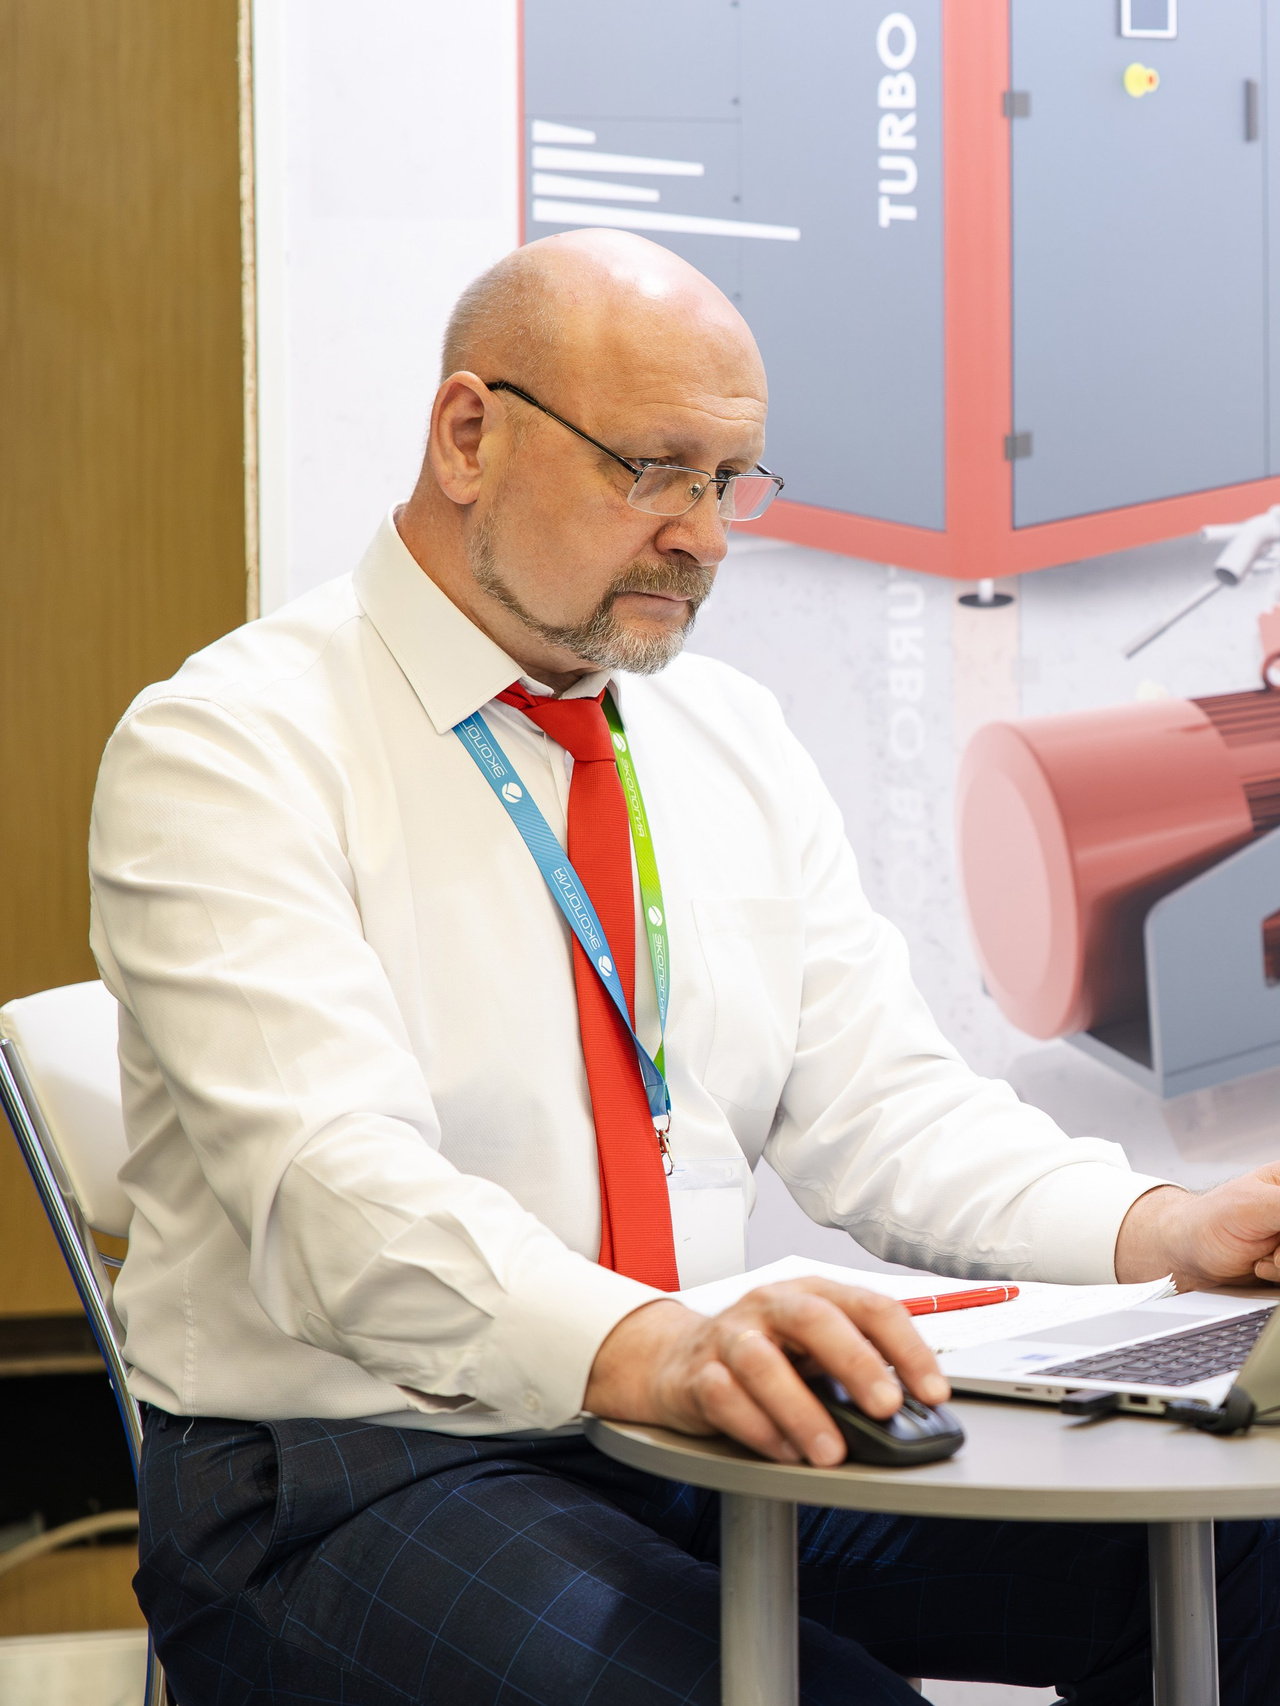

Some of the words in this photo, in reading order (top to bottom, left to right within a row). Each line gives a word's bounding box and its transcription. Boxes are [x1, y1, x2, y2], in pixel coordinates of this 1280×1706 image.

[876, 12, 918, 228] TURBO
[621, 757, 645, 838] ЭКОЛОГИЯ
[553, 867, 600, 950] ЭКОЛОГИЯ
